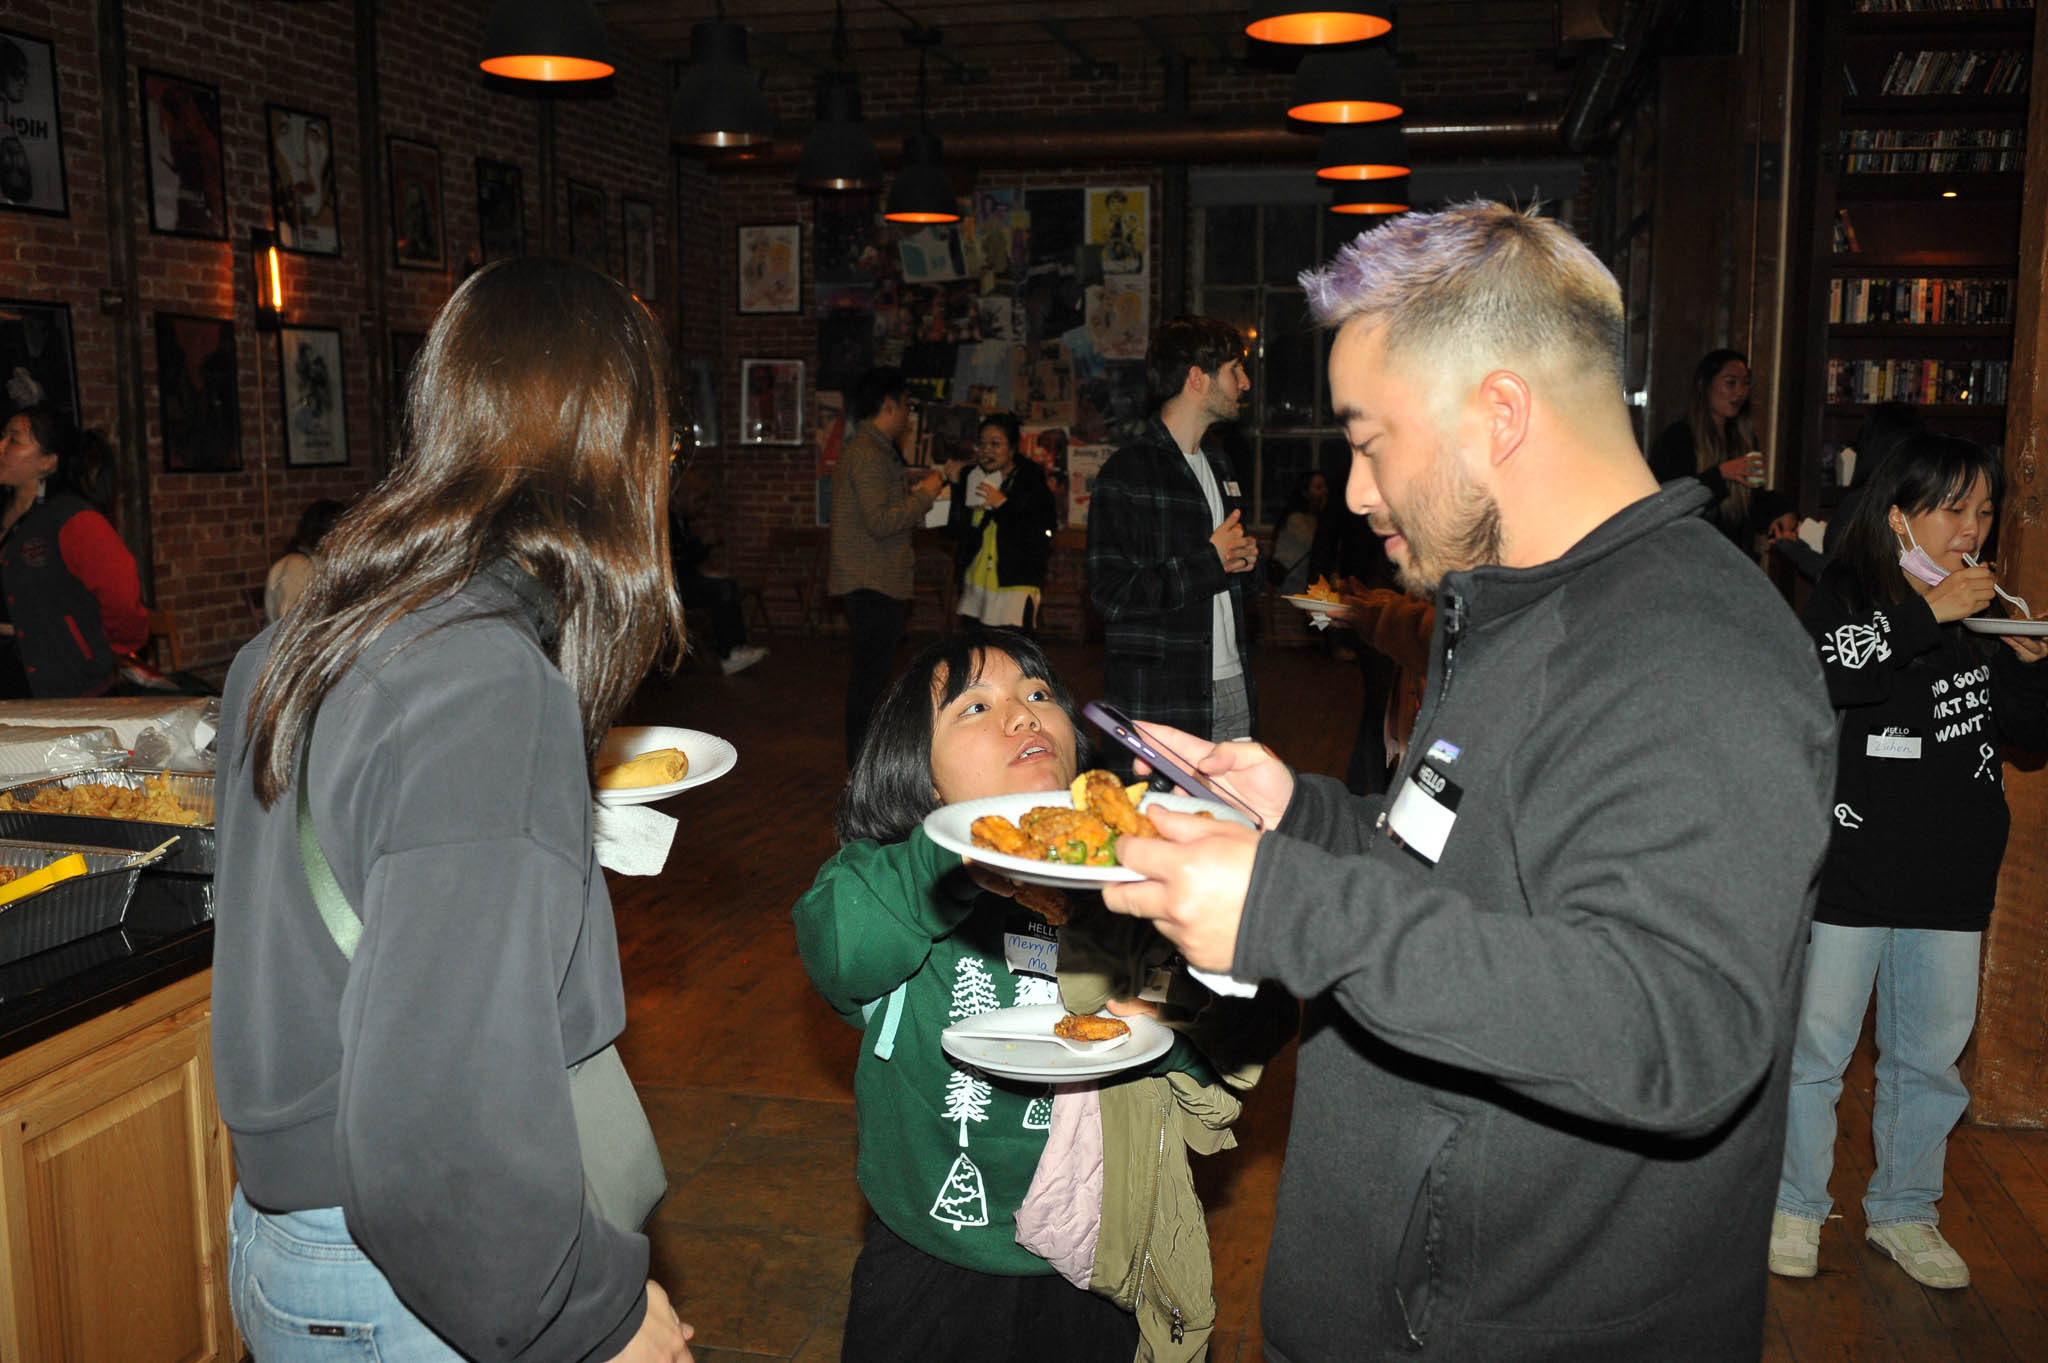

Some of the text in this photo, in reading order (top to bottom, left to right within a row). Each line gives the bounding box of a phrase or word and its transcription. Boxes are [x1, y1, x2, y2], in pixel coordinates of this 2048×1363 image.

[1879, 616, 1892, 634] BUY
[1931, 665, 1990, 698] NO GOOD
[1933, 697, 1962, 719] ART
[1884, 726, 1910, 735] HELLO
[1028, 921, 1055, 937] HELL
[1008, 935, 1044, 957] Merry
[1027, 957, 1048, 972] Ma
